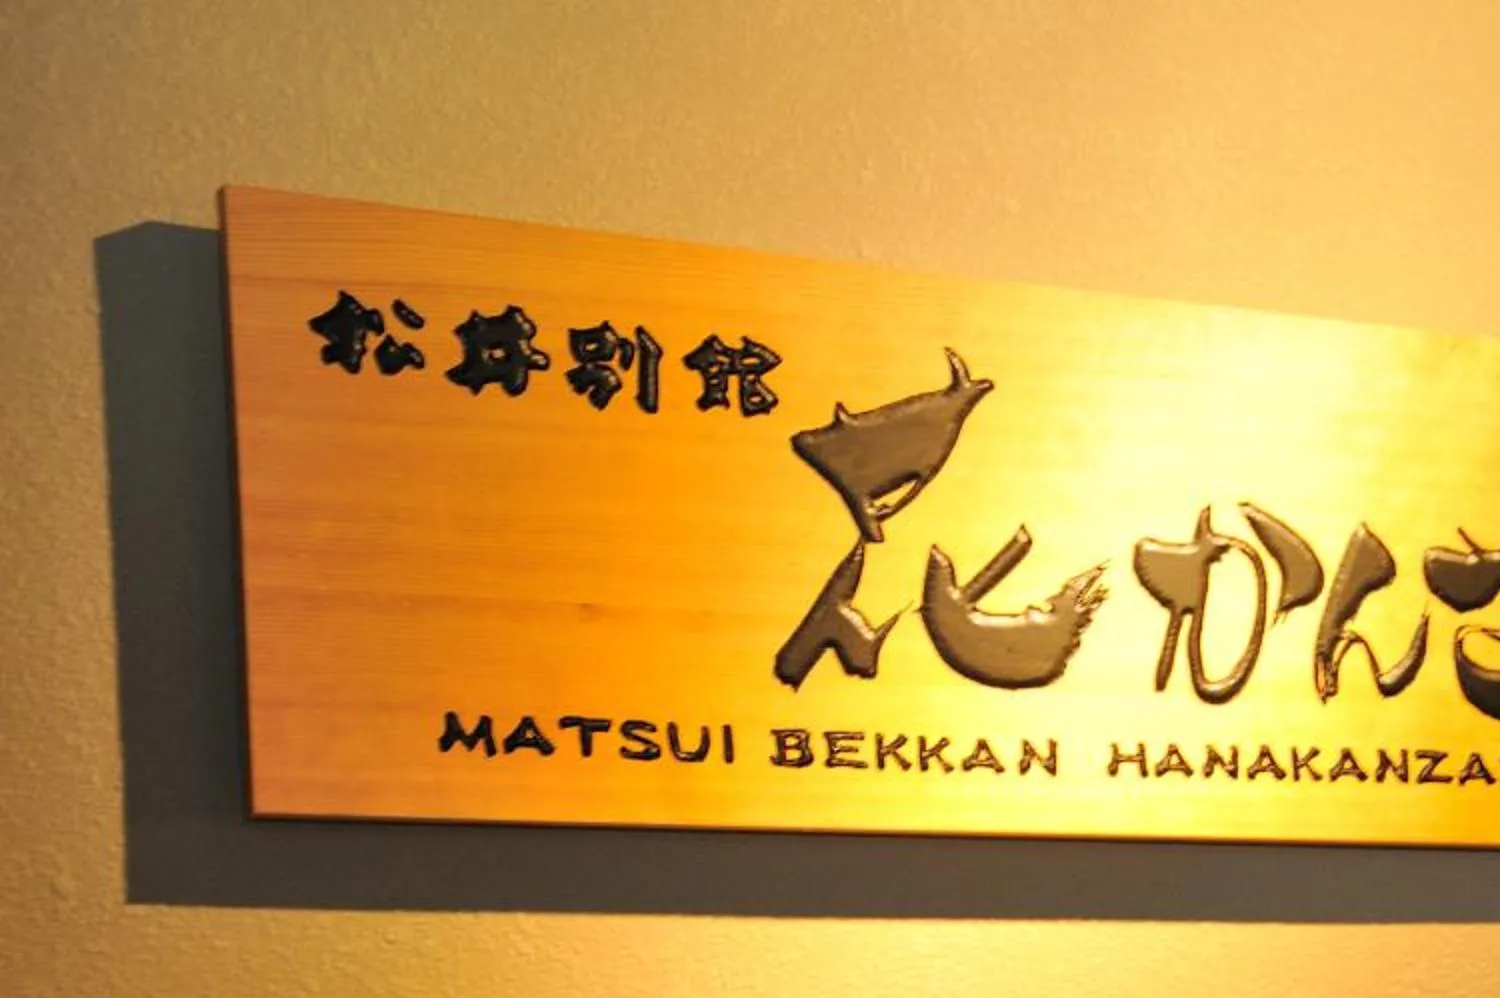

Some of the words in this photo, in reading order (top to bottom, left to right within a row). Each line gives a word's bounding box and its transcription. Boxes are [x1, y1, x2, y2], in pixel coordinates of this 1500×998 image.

[309, 290, 782, 416] 松井別館
[438, 712, 735, 764] MATSUI
[770, 728, 1058, 777] BEKKAN
